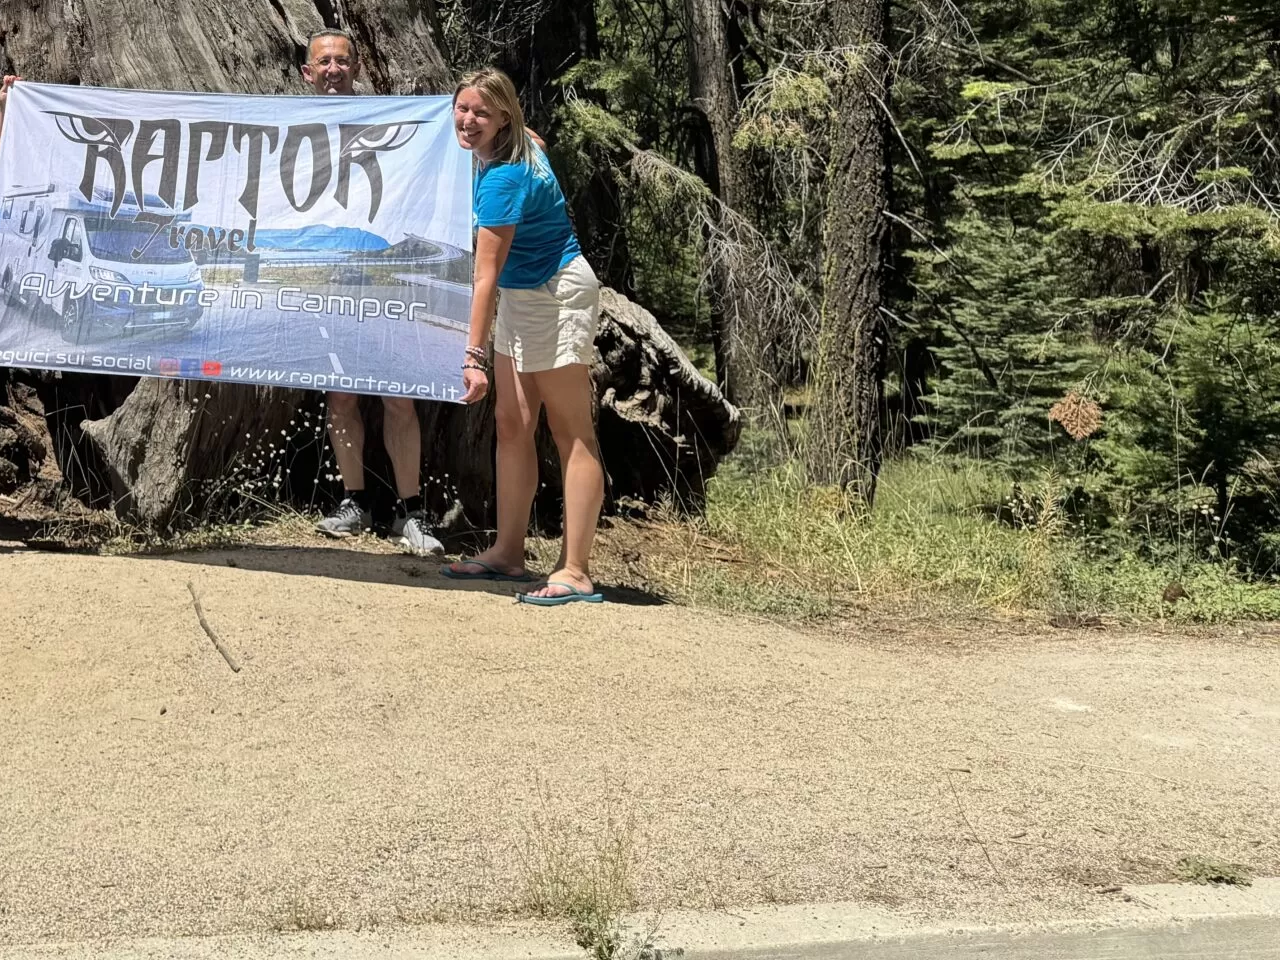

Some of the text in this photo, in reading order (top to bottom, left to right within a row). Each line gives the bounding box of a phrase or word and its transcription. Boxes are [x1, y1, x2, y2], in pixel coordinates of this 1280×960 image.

[56, 112, 410, 224] RAPTOR
[130, 211, 258, 260] Travel
[18, 272, 427, 323] Avventure in Camper
[55, 350, 86, 366] sui
[91, 354, 152, 371] social
[230, 365, 460, 401] www.raptortravel.it
